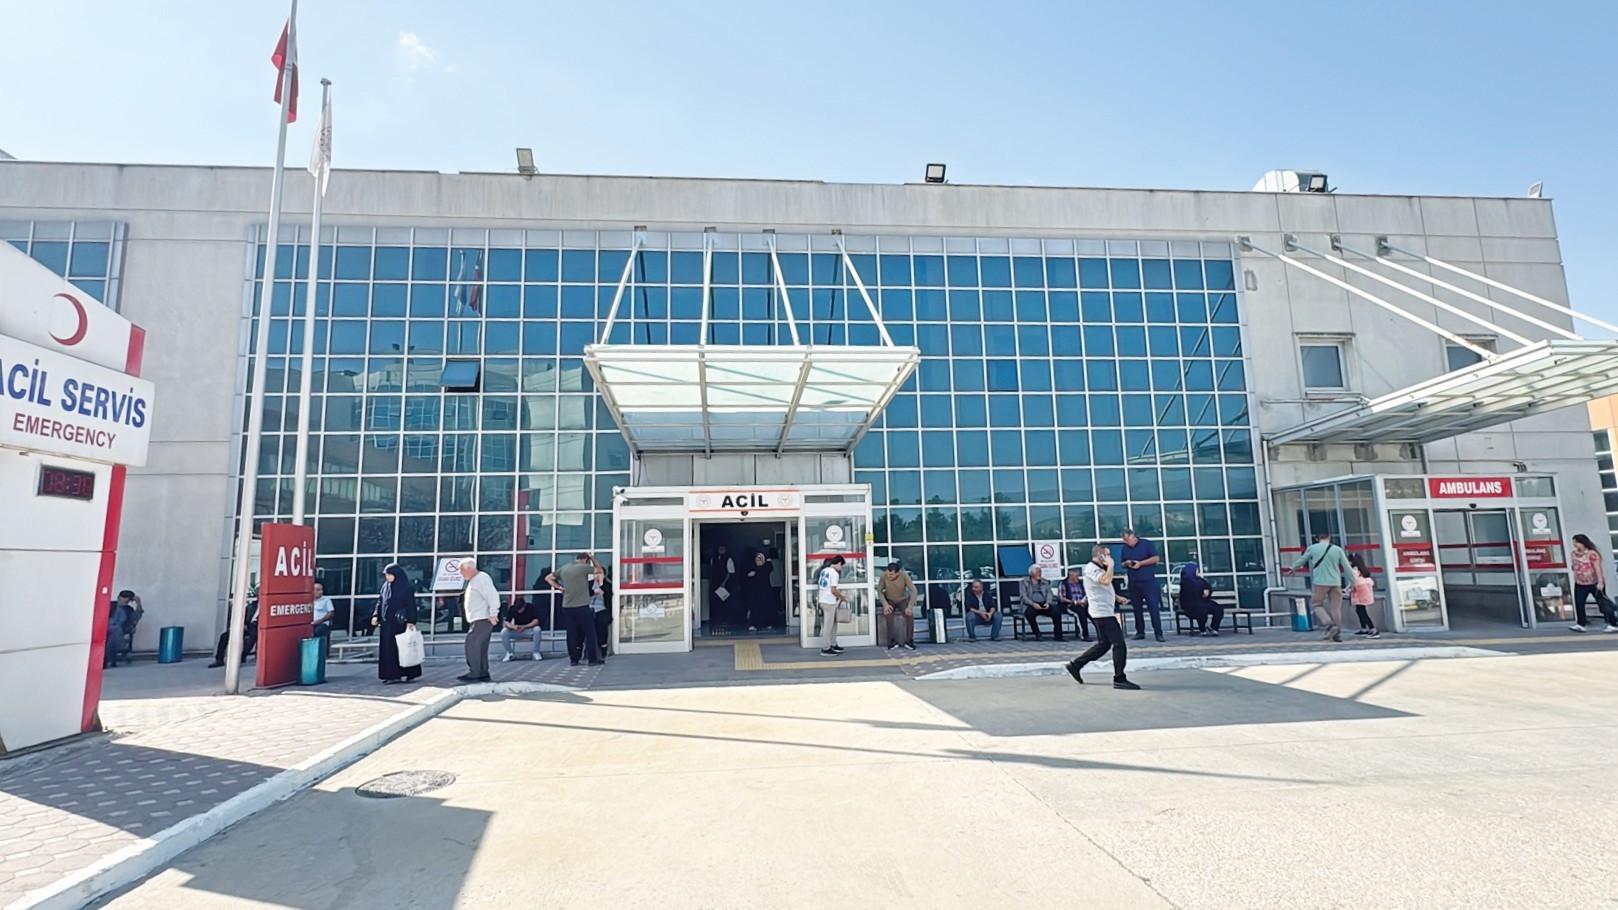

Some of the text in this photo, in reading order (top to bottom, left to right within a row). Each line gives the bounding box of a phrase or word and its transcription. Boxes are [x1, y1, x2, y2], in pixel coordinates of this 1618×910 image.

[0, 358, 146, 428] CİL SERVİS
[13, 413, 116, 449] EMERGENCY
[721, 493, 769, 508] ACİL
[1439, 482, 1502, 494] AMBULANS
[274, 541, 314, 577] ACİL
[270, 604, 312, 617] EMERGENC
